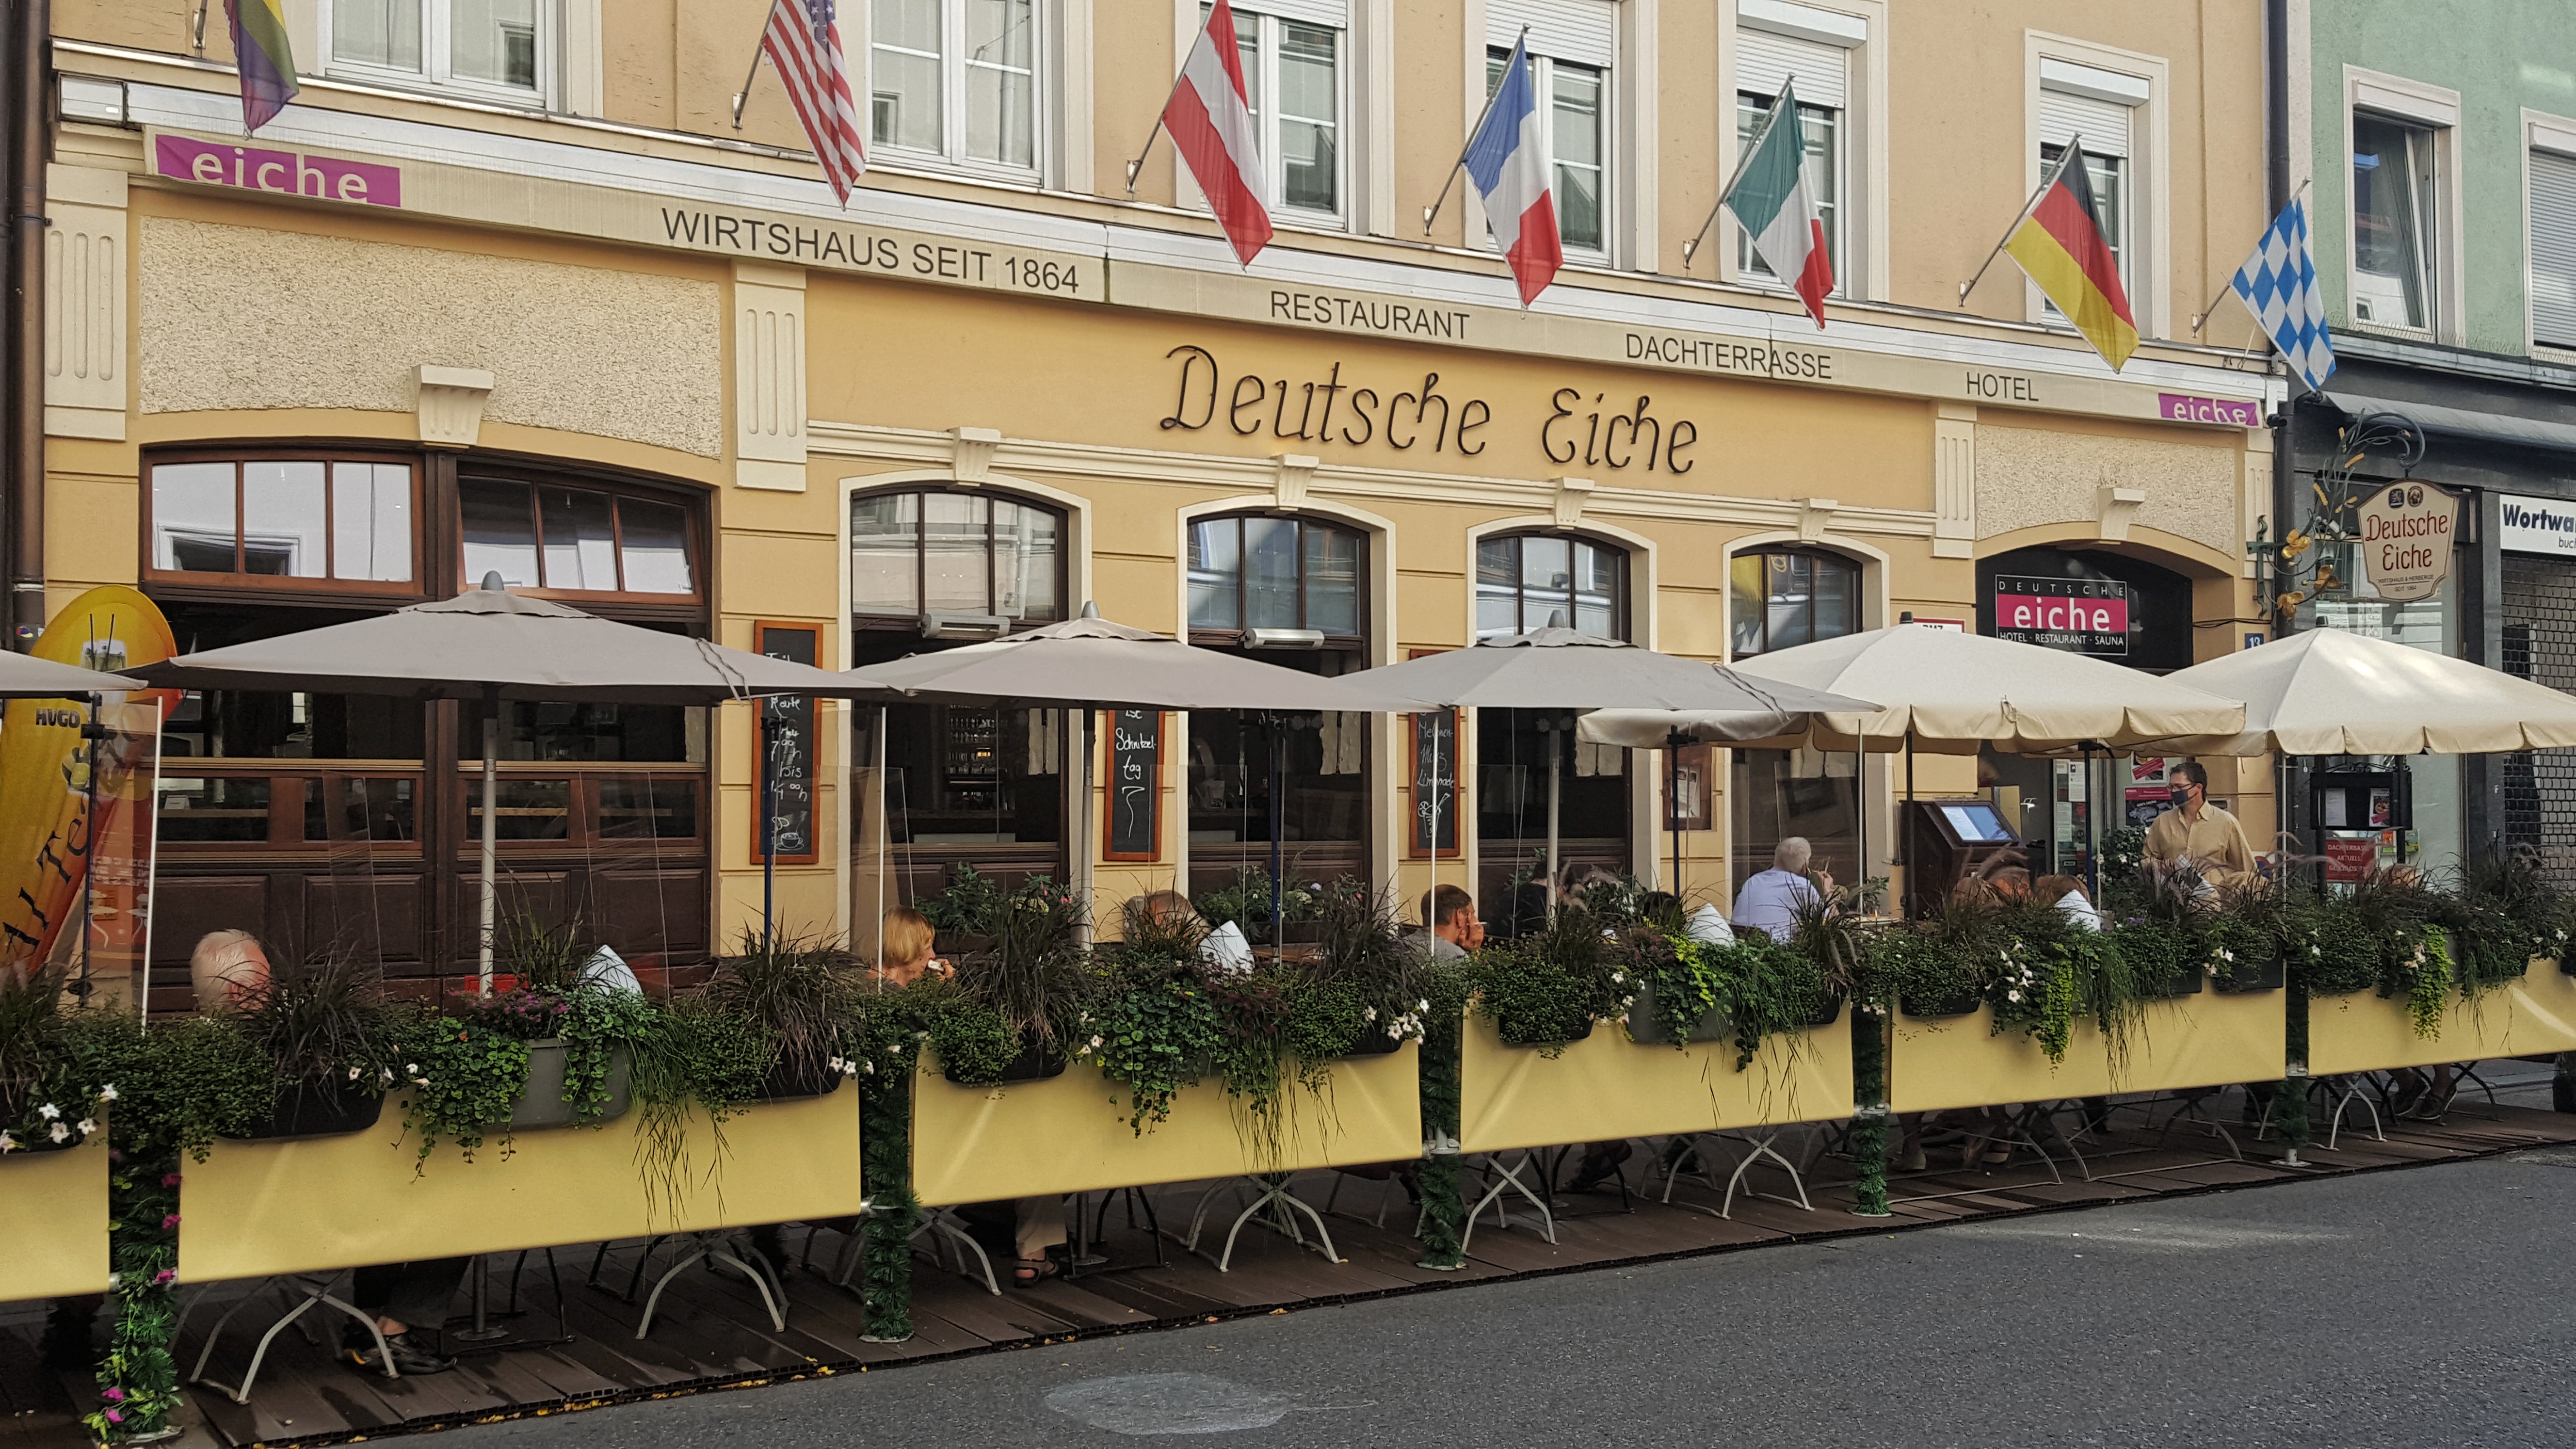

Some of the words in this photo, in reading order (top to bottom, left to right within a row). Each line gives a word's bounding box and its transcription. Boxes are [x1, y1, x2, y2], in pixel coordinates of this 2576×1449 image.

[193, 147, 369, 204] eiche
[661, 207, 899, 269] WIRTSHAUS
[912, 243, 992, 281] SEIT
[1004, 257, 1079, 294] 1864
[1270, 290, 1470, 340] RESTAURANT
[1626, 333, 1832, 379] DACHTERRASSE
[1966, 371, 2039, 402] HOTEL
[1159, 345, 1491, 456] Deutsche
[1541, 388, 1697, 474] Eiche
[2174, 397, 2247, 424] eiche
[2365, 510, 2447, 542] Deutsche
[2503, 503, 2576, 532] Wortwa
[2382, 544, 2432, 571] Eiche
[1999, 581, 2124, 596] DEUTSCHE
[2013, 597, 2110, 631] eiche
[2000, 631, 2028, 643] HOTEL
[2035, 633, 2086, 645] RESTAURANT
[2095, 636, 2124, 646] SAUNA
[2249, 636, 2261, 648] 13
[35, 708, 81, 728] HUGO
[1418, 721, 1454, 740] Melnen-
[779, 761, 802, 778] bis
[1123, 754, 1141, 780] tag
[1420, 743, 1447, 772] Miz
[1417, 768, 1455, 789] Limnade
